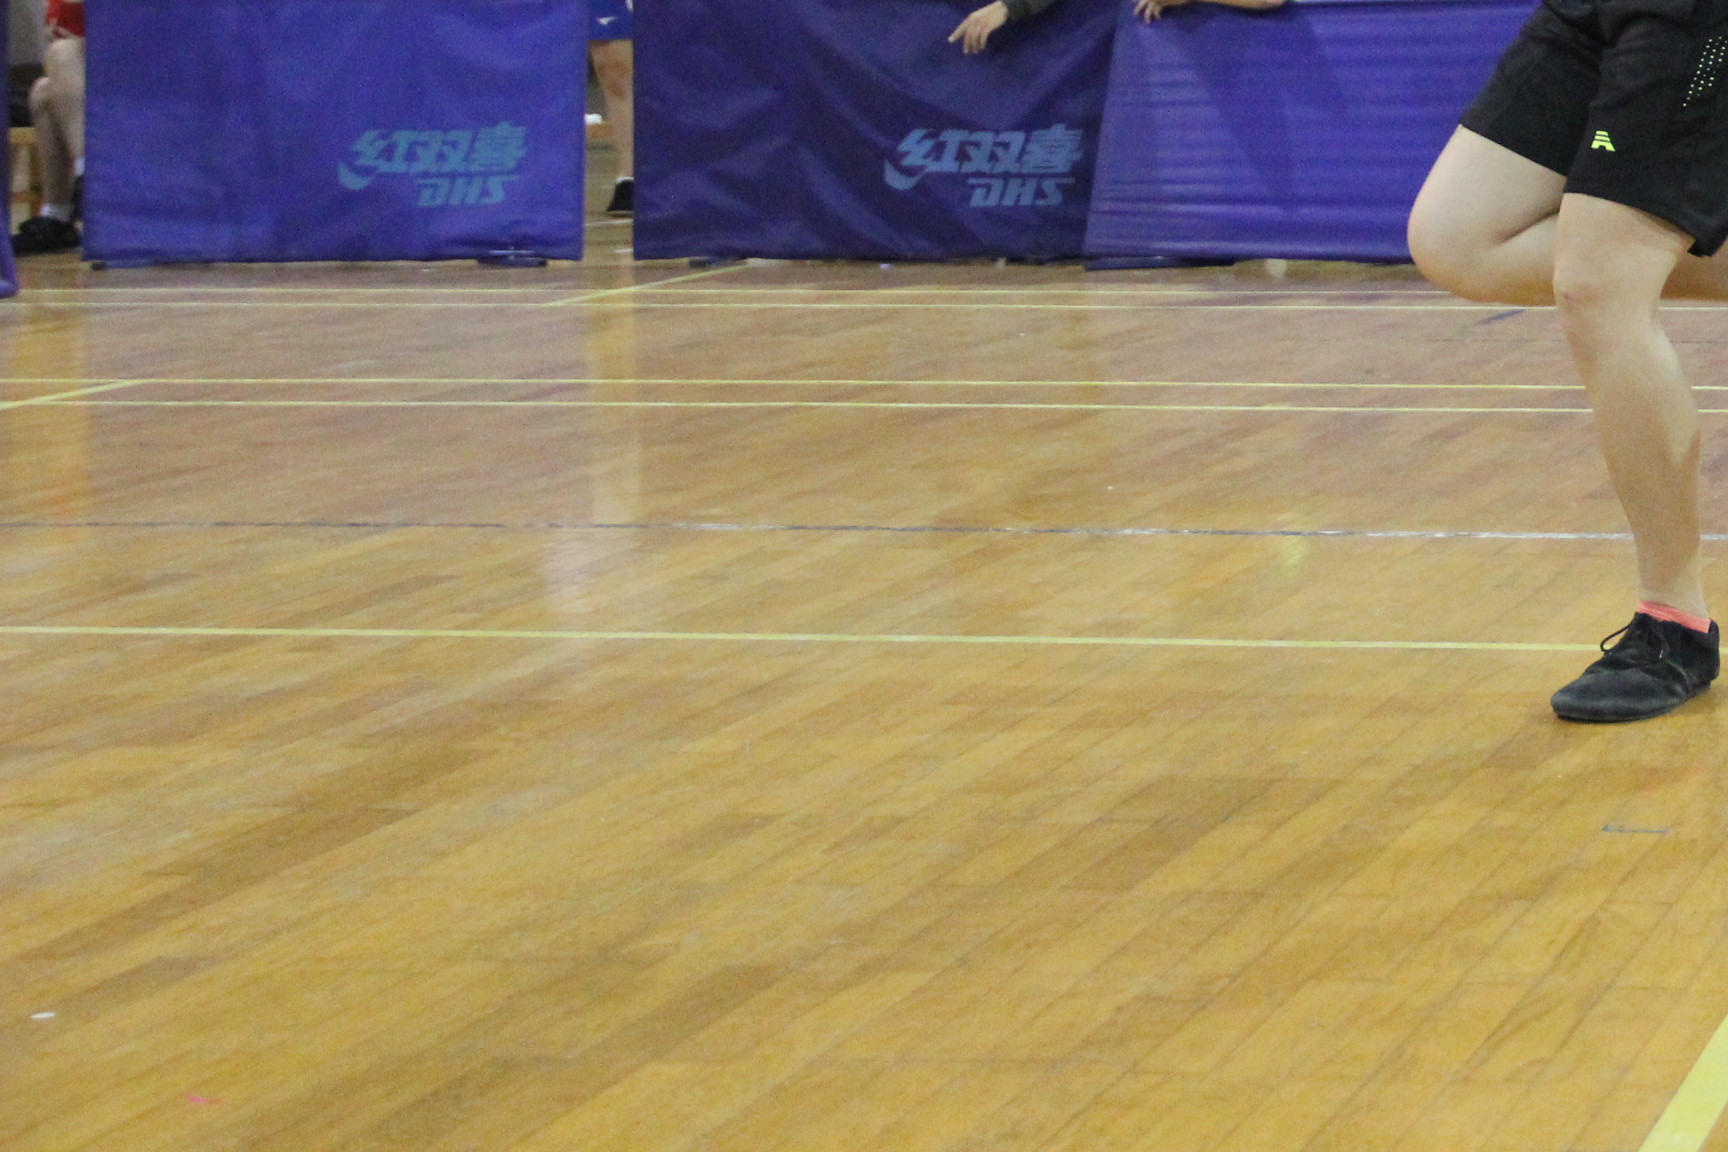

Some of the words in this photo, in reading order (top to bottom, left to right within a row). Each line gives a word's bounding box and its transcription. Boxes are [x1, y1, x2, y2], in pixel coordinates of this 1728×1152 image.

[351, 121, 528, 173] 红双喜
[897, 123, 1084, 174] 红双喜
[416, 174, 520, 207] DHS
[966, 177, 1076, 208] DHS
